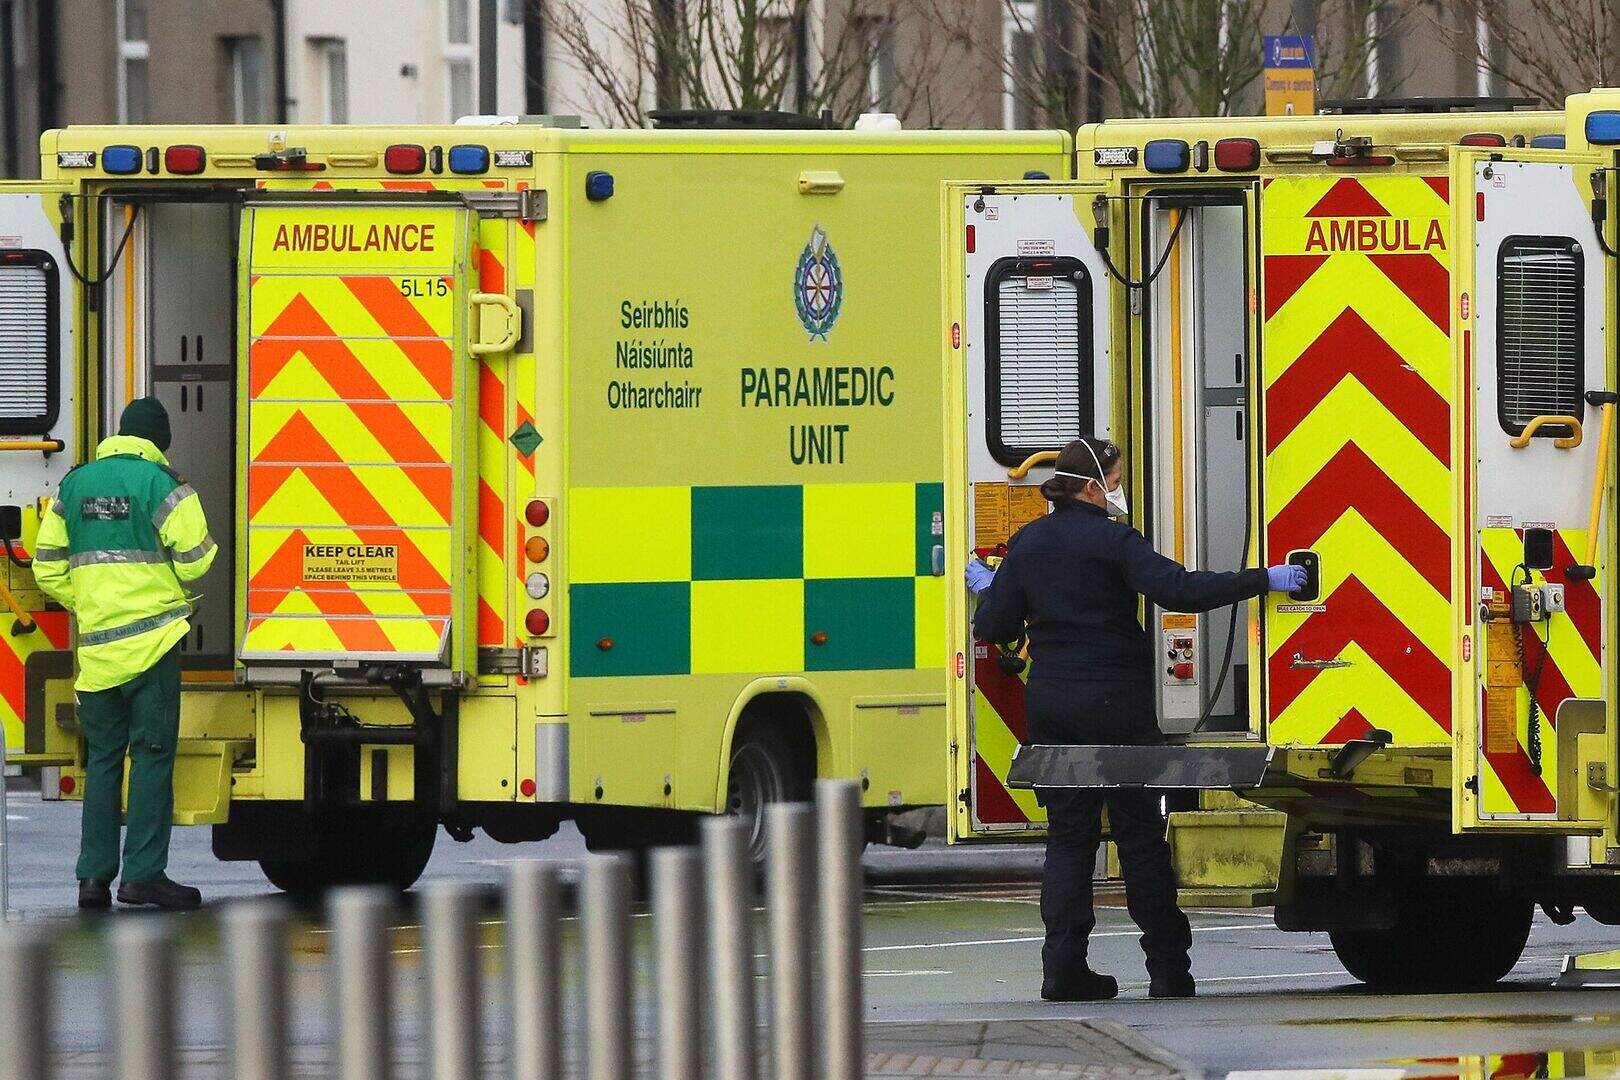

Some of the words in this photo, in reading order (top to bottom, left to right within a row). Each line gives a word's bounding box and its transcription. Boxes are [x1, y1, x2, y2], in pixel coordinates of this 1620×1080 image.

[272, 224, 435, 252] AMBULANCE
[1305, 219, 1447, 251] AMBULA
[401, 279, 448, 297] 5L15
[621, 299, 689, 329] Seirbhís
[616, 339, 694, 369] Náisiúnta
[607, 380, 702, 409] Otharchairr
[741, 366, 894, 407] PARAMEDIC
[790, 424, 849, 465] UNIT
[305, 546, 344, 557] KEEP
[347, 546, 394, 557] CLEAR
